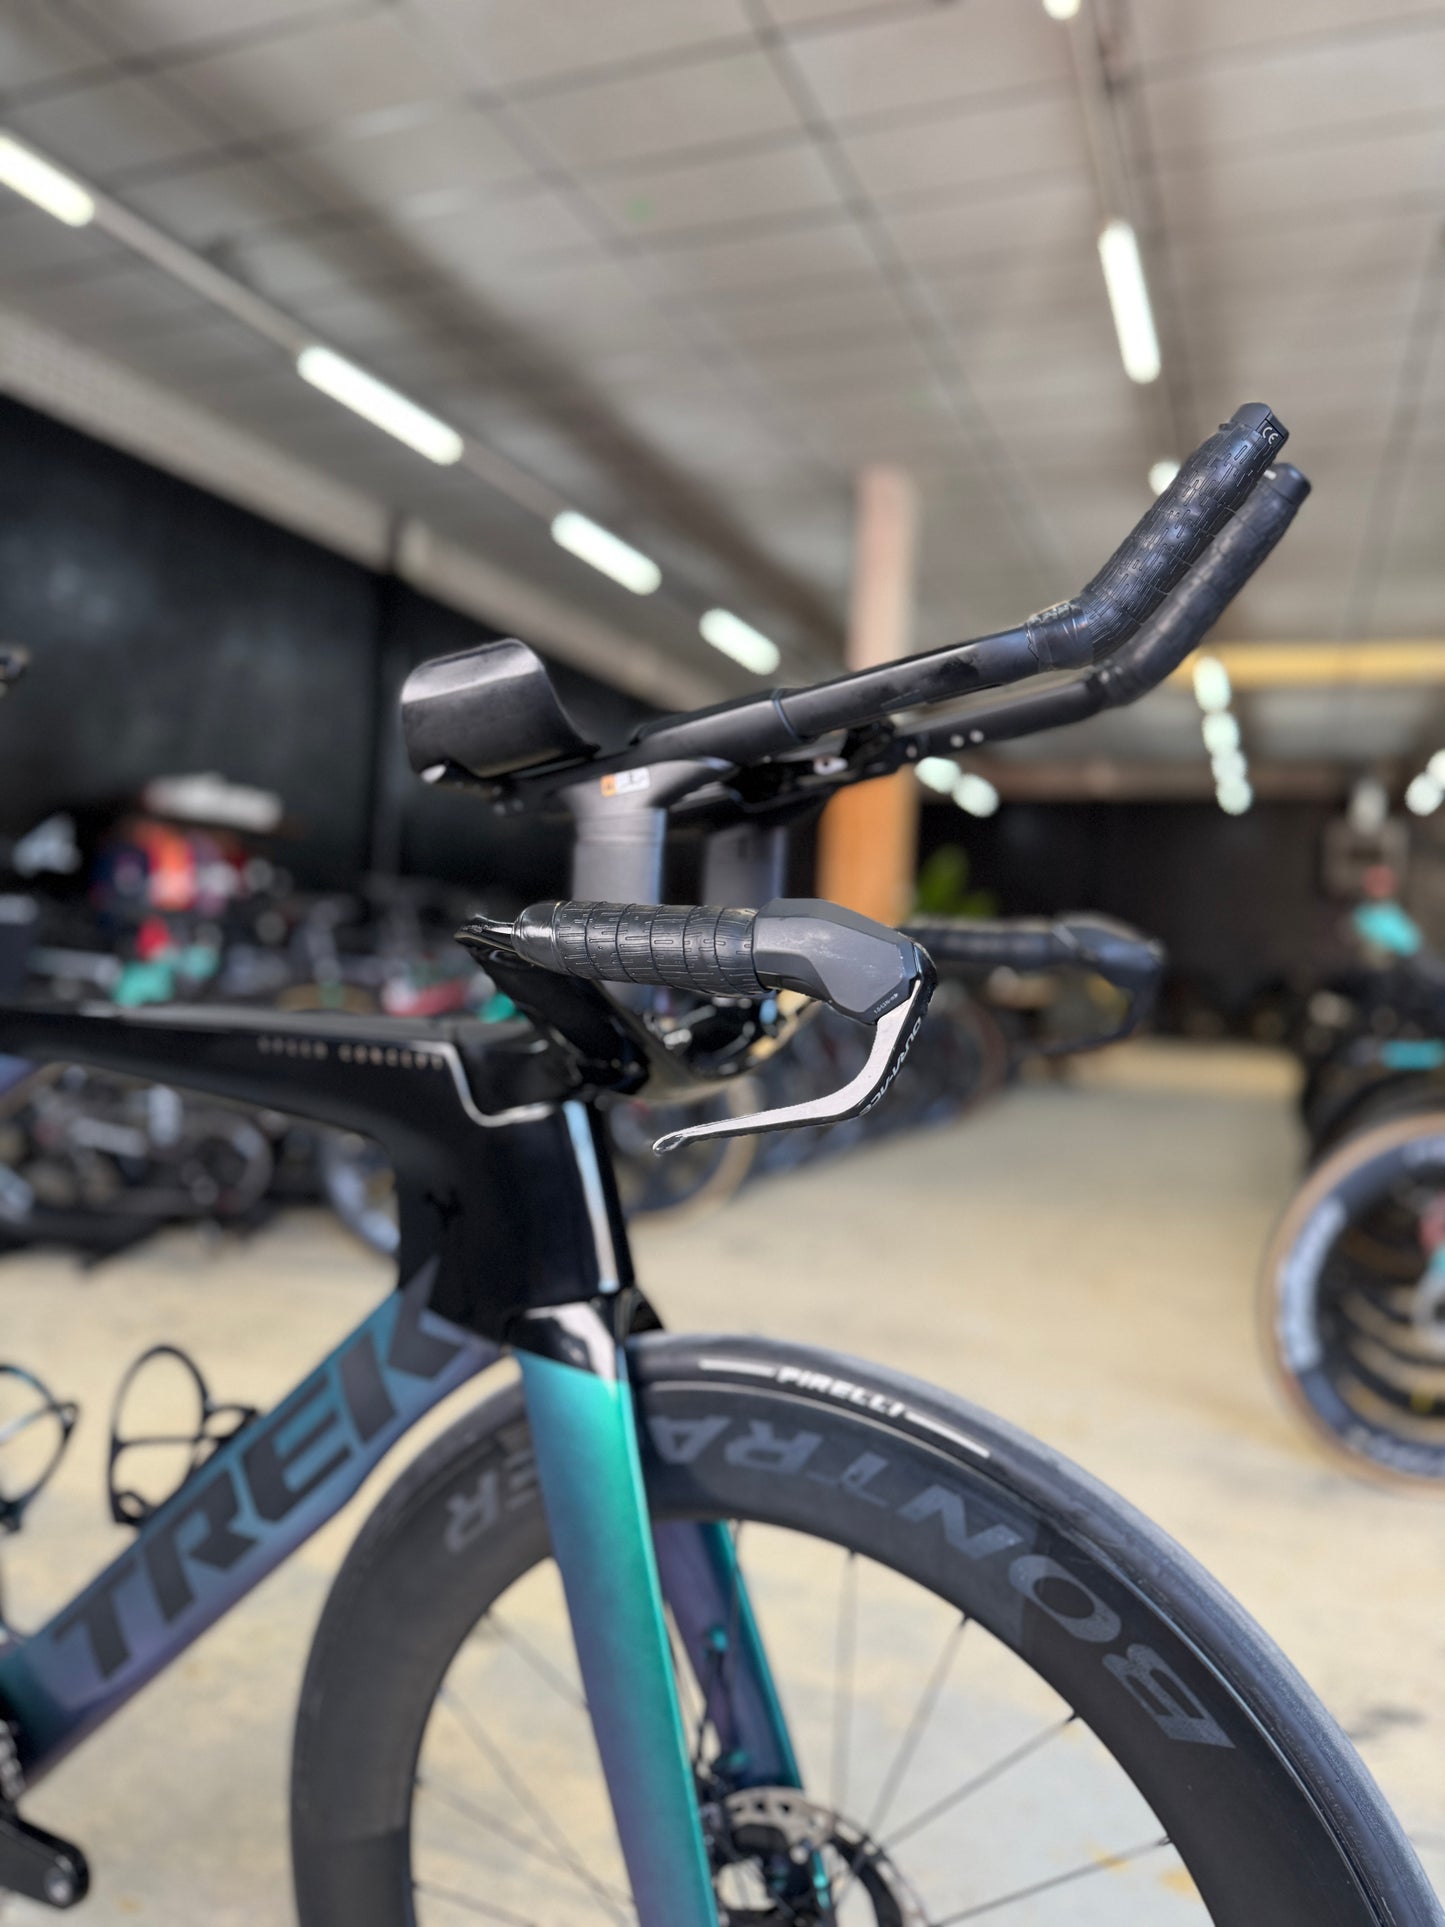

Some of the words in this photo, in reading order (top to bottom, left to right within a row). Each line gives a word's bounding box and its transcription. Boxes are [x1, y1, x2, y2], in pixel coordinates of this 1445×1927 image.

[1262, 426, 1279, 445] CE
[857, 1016, 922, 1117] DURA-ACE
[777, 1366, 905, 1418] PIRELLI
[52, 1254, 464, 1680] TREK
[445, 1415, 1236, 1749] BONTRAER
